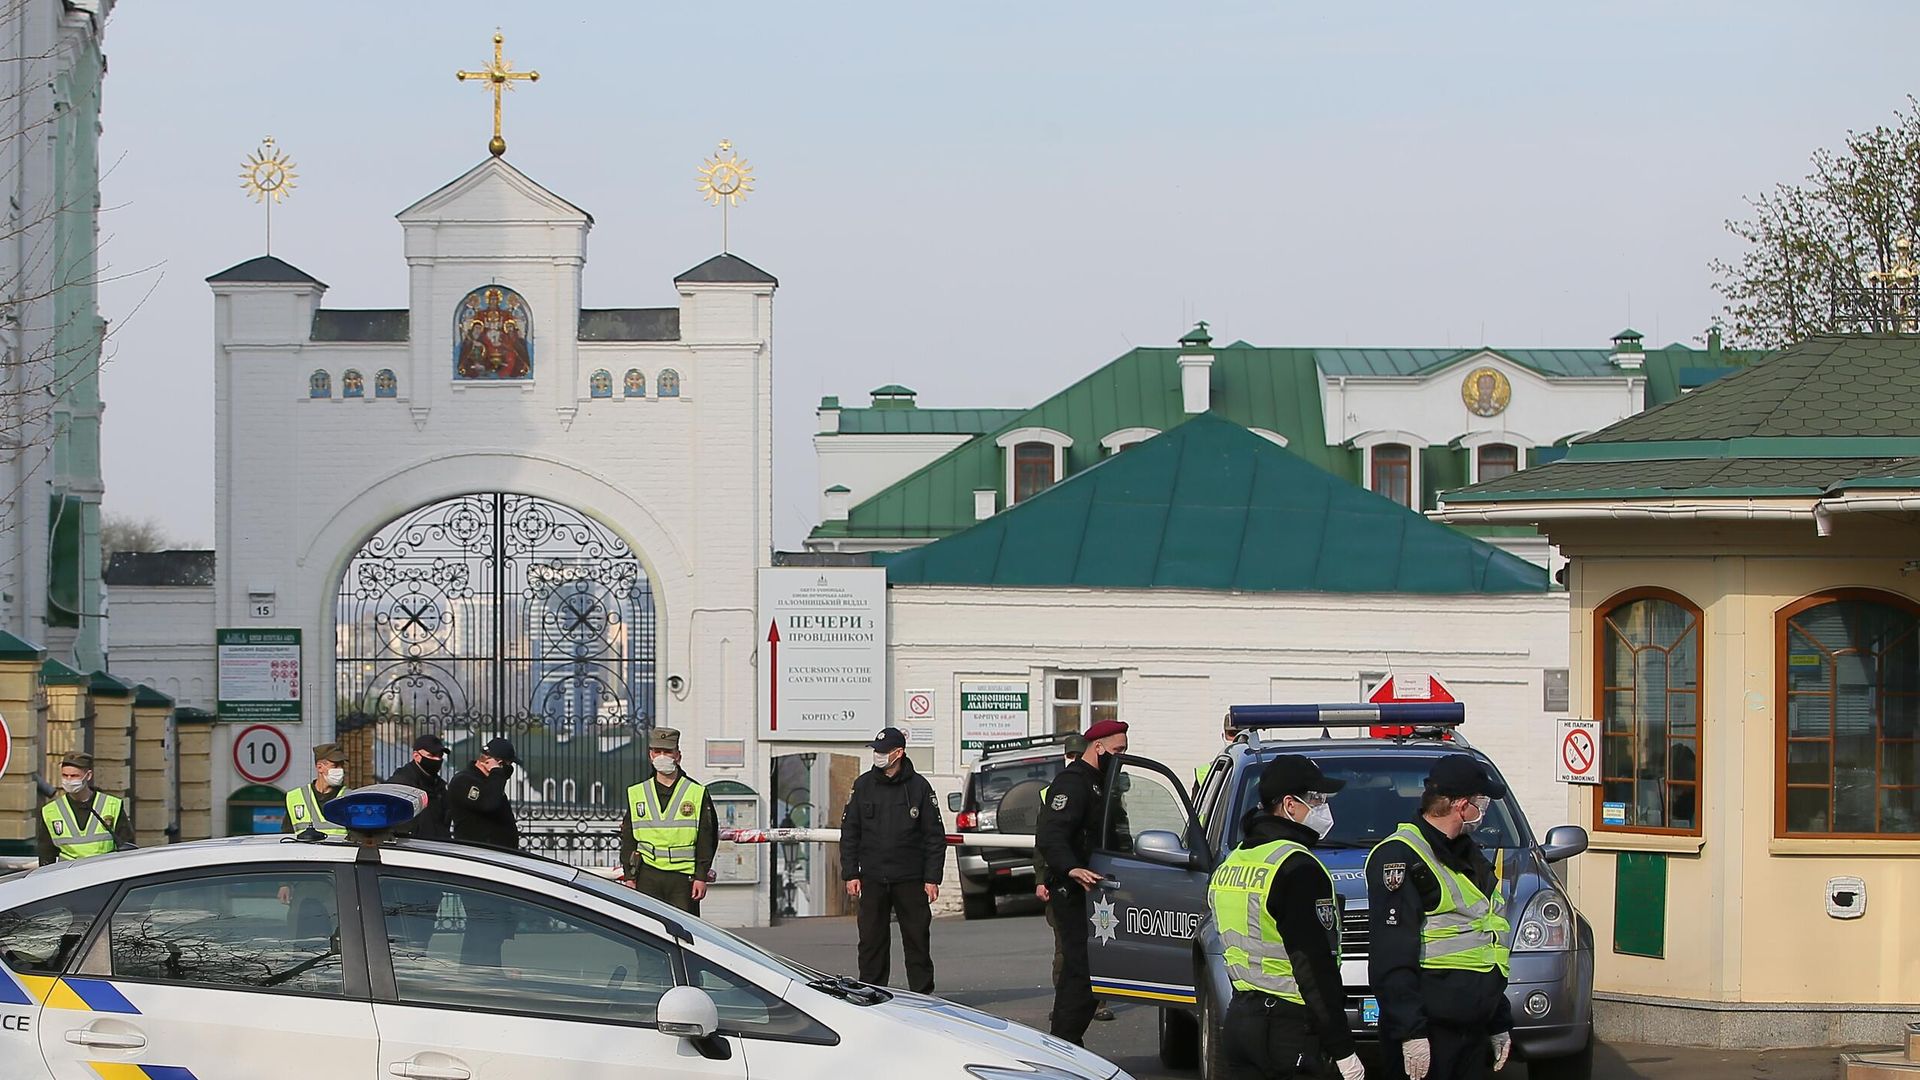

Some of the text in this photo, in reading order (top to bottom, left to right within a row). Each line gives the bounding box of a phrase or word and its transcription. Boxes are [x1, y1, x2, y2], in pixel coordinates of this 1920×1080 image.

[256, 606, 269, 615] 15
[789, 615, 862, 629] ПЕЧЕРИ
[789, 633, 874, 642] ПРОВІДНИКОМ
[801, 710, 855, 721] КОРПУС 39
[246, 742, 277, 764] 10
[1126, 907, 1199, 940] ПОЛІЦІЯ
